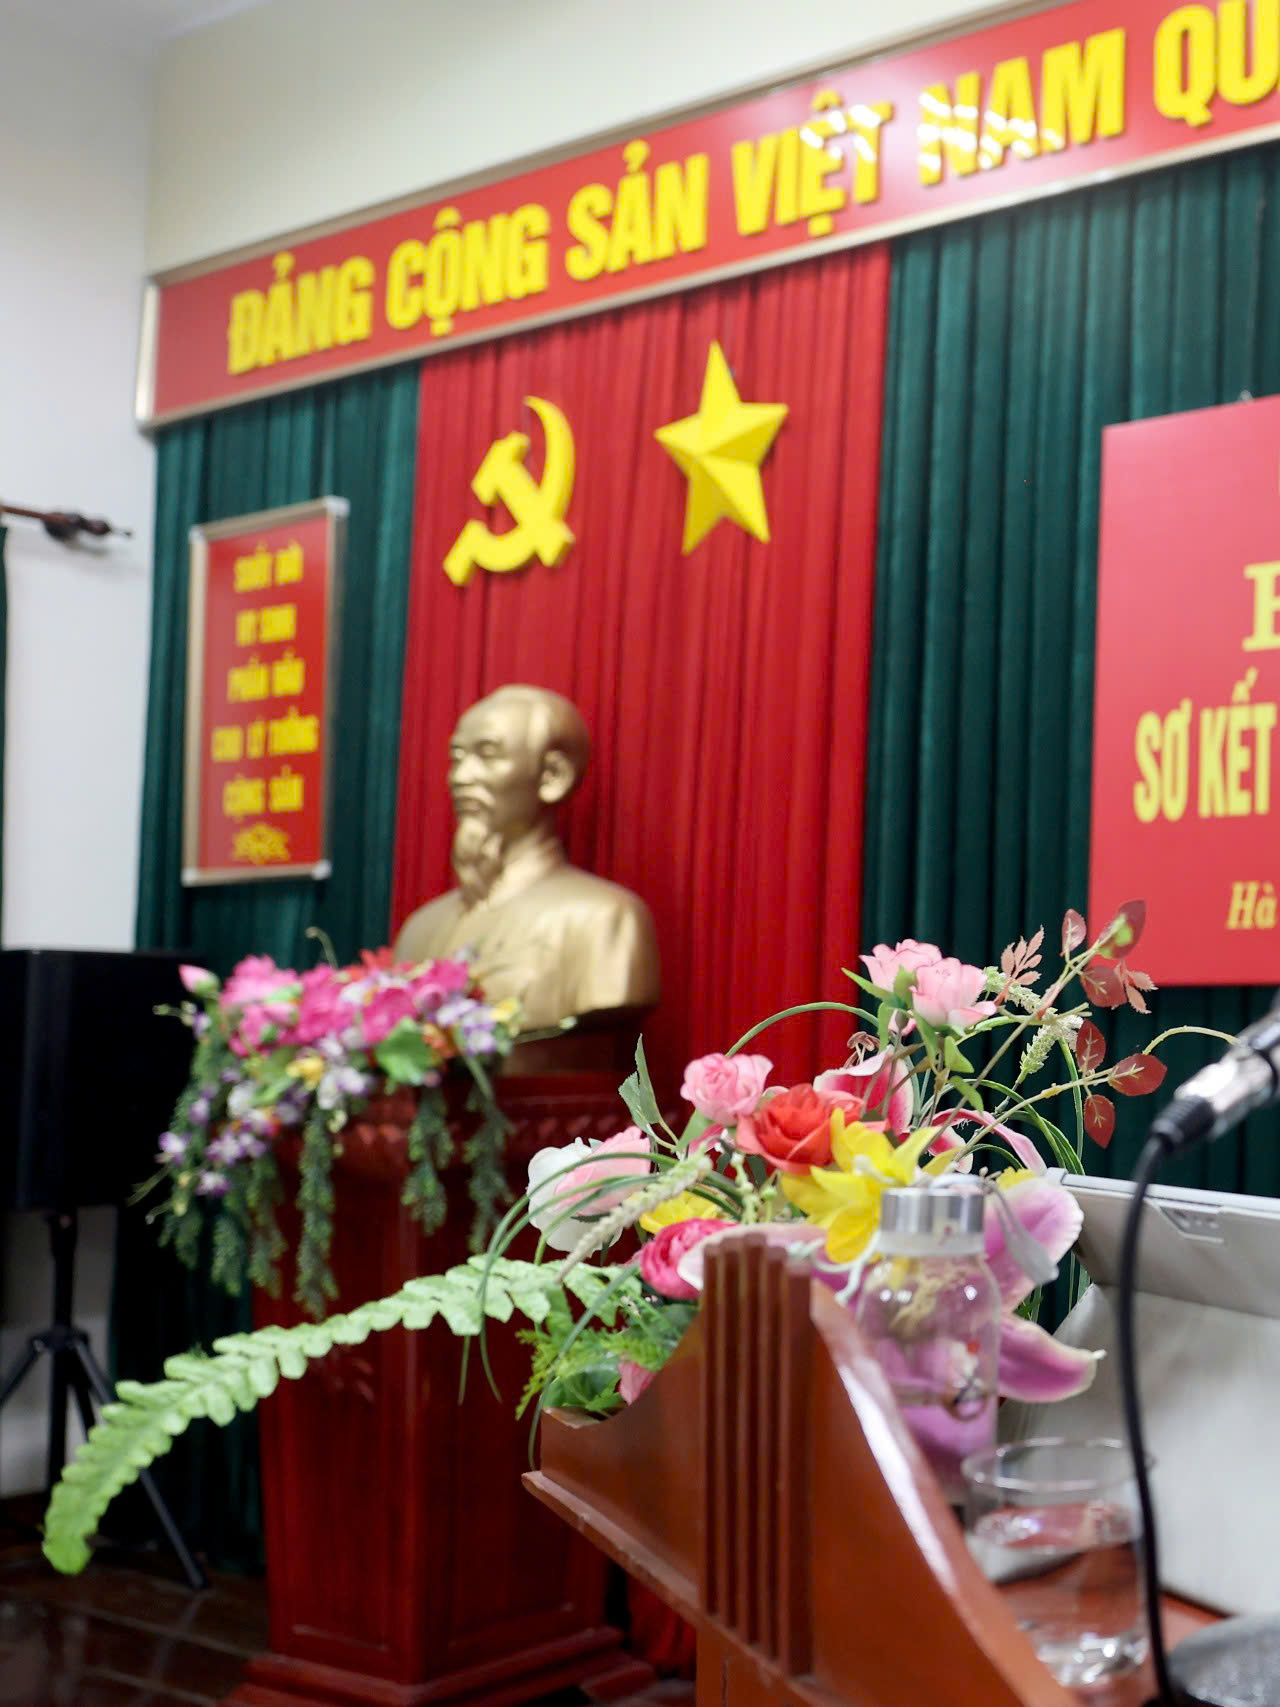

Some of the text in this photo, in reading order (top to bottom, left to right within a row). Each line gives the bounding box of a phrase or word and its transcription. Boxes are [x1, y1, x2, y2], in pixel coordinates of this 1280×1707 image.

[228, 252, 374, 375] ĐẢNG
[386, 207, 549, 336] CỘNG
[565, 140, 709, 281] SẢN
[732, 90, 893, 236] VIỆT
[918, 29, 1126, 185] NAM
[1133, 697, 1193, 823] SƠ
[1198, 666, 1277, 818] KẾT
[1226, 880, 1277, 930] Hà
